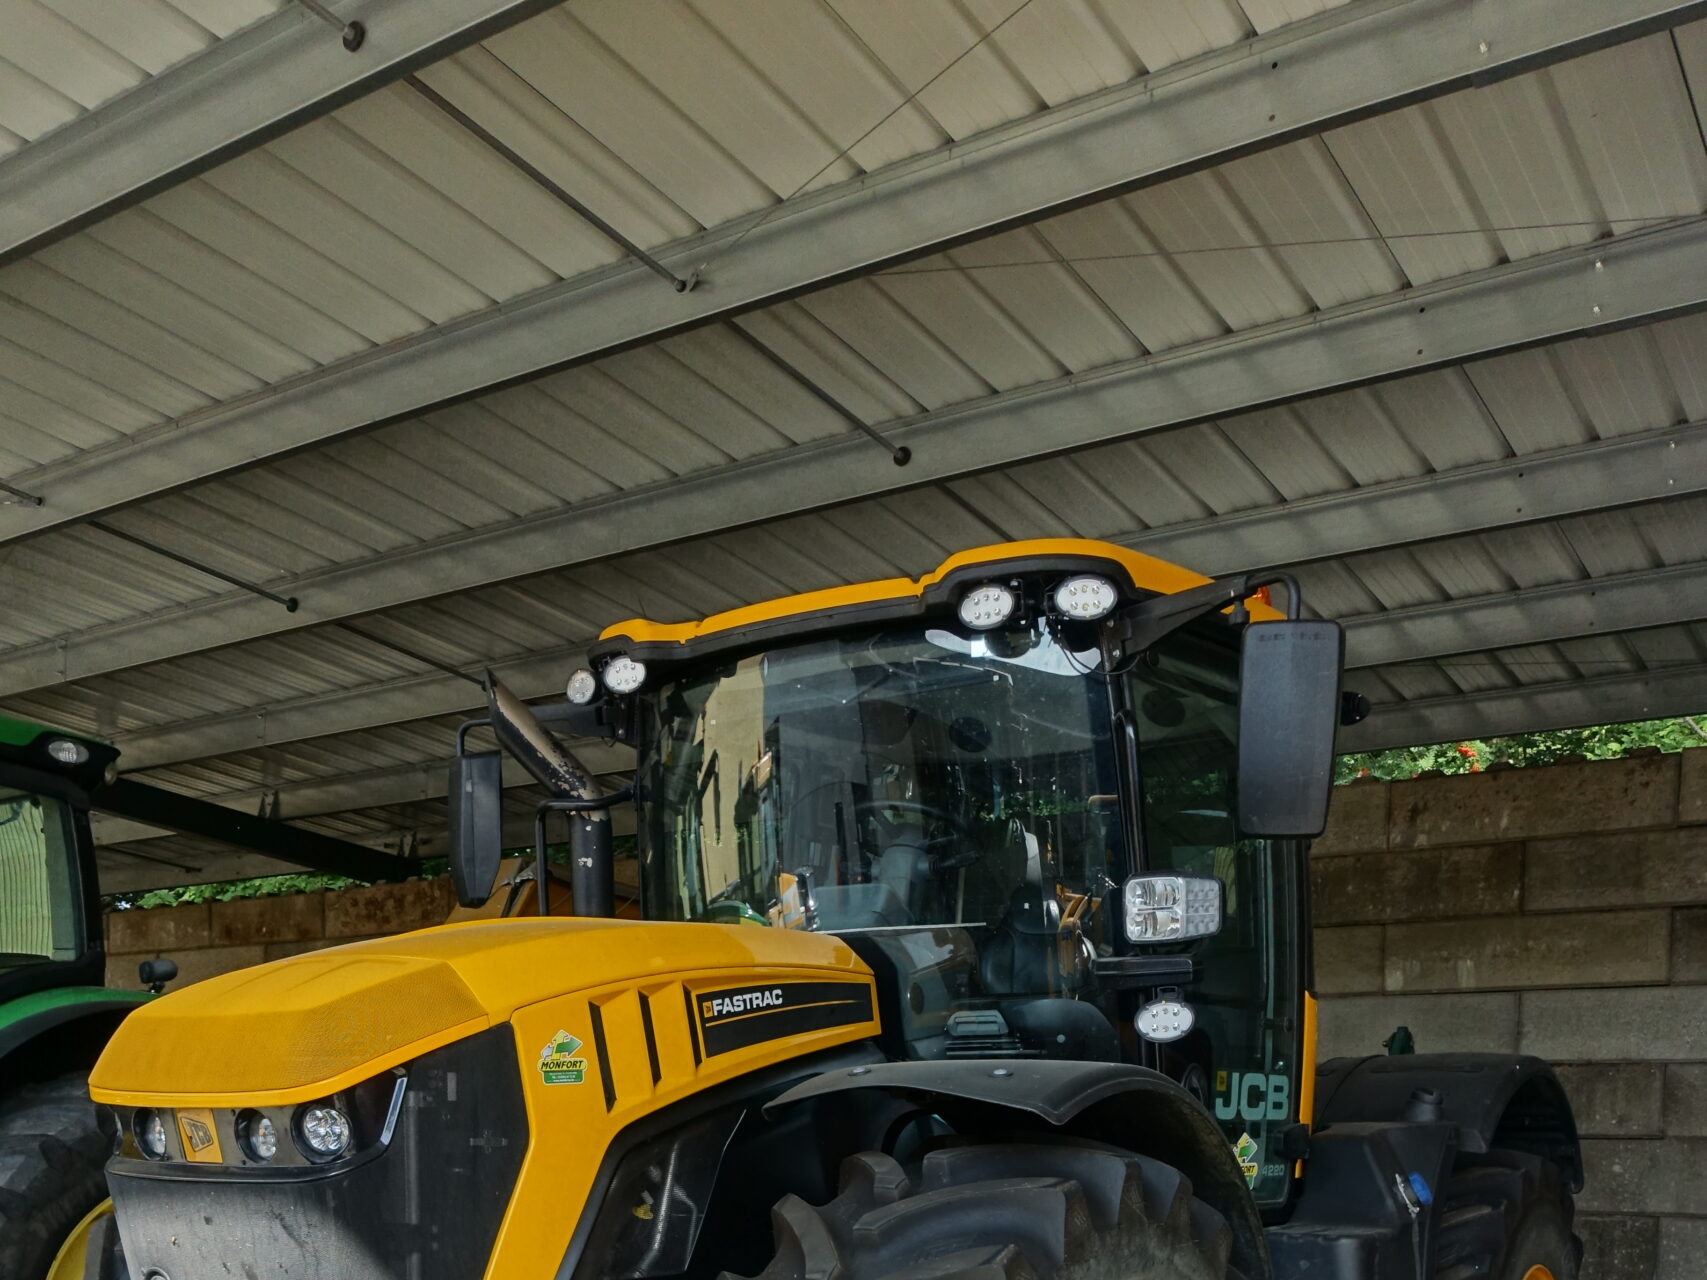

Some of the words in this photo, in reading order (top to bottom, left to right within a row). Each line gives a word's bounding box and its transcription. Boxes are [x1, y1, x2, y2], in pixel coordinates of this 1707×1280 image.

[712, 989, 783, 1016] FASTRAC
[540, 1060, 584, 1070] MONFORT
[1215, 1072, 1289, 1120] JCB
[1261, 1164, 1285, 1176] 4220
